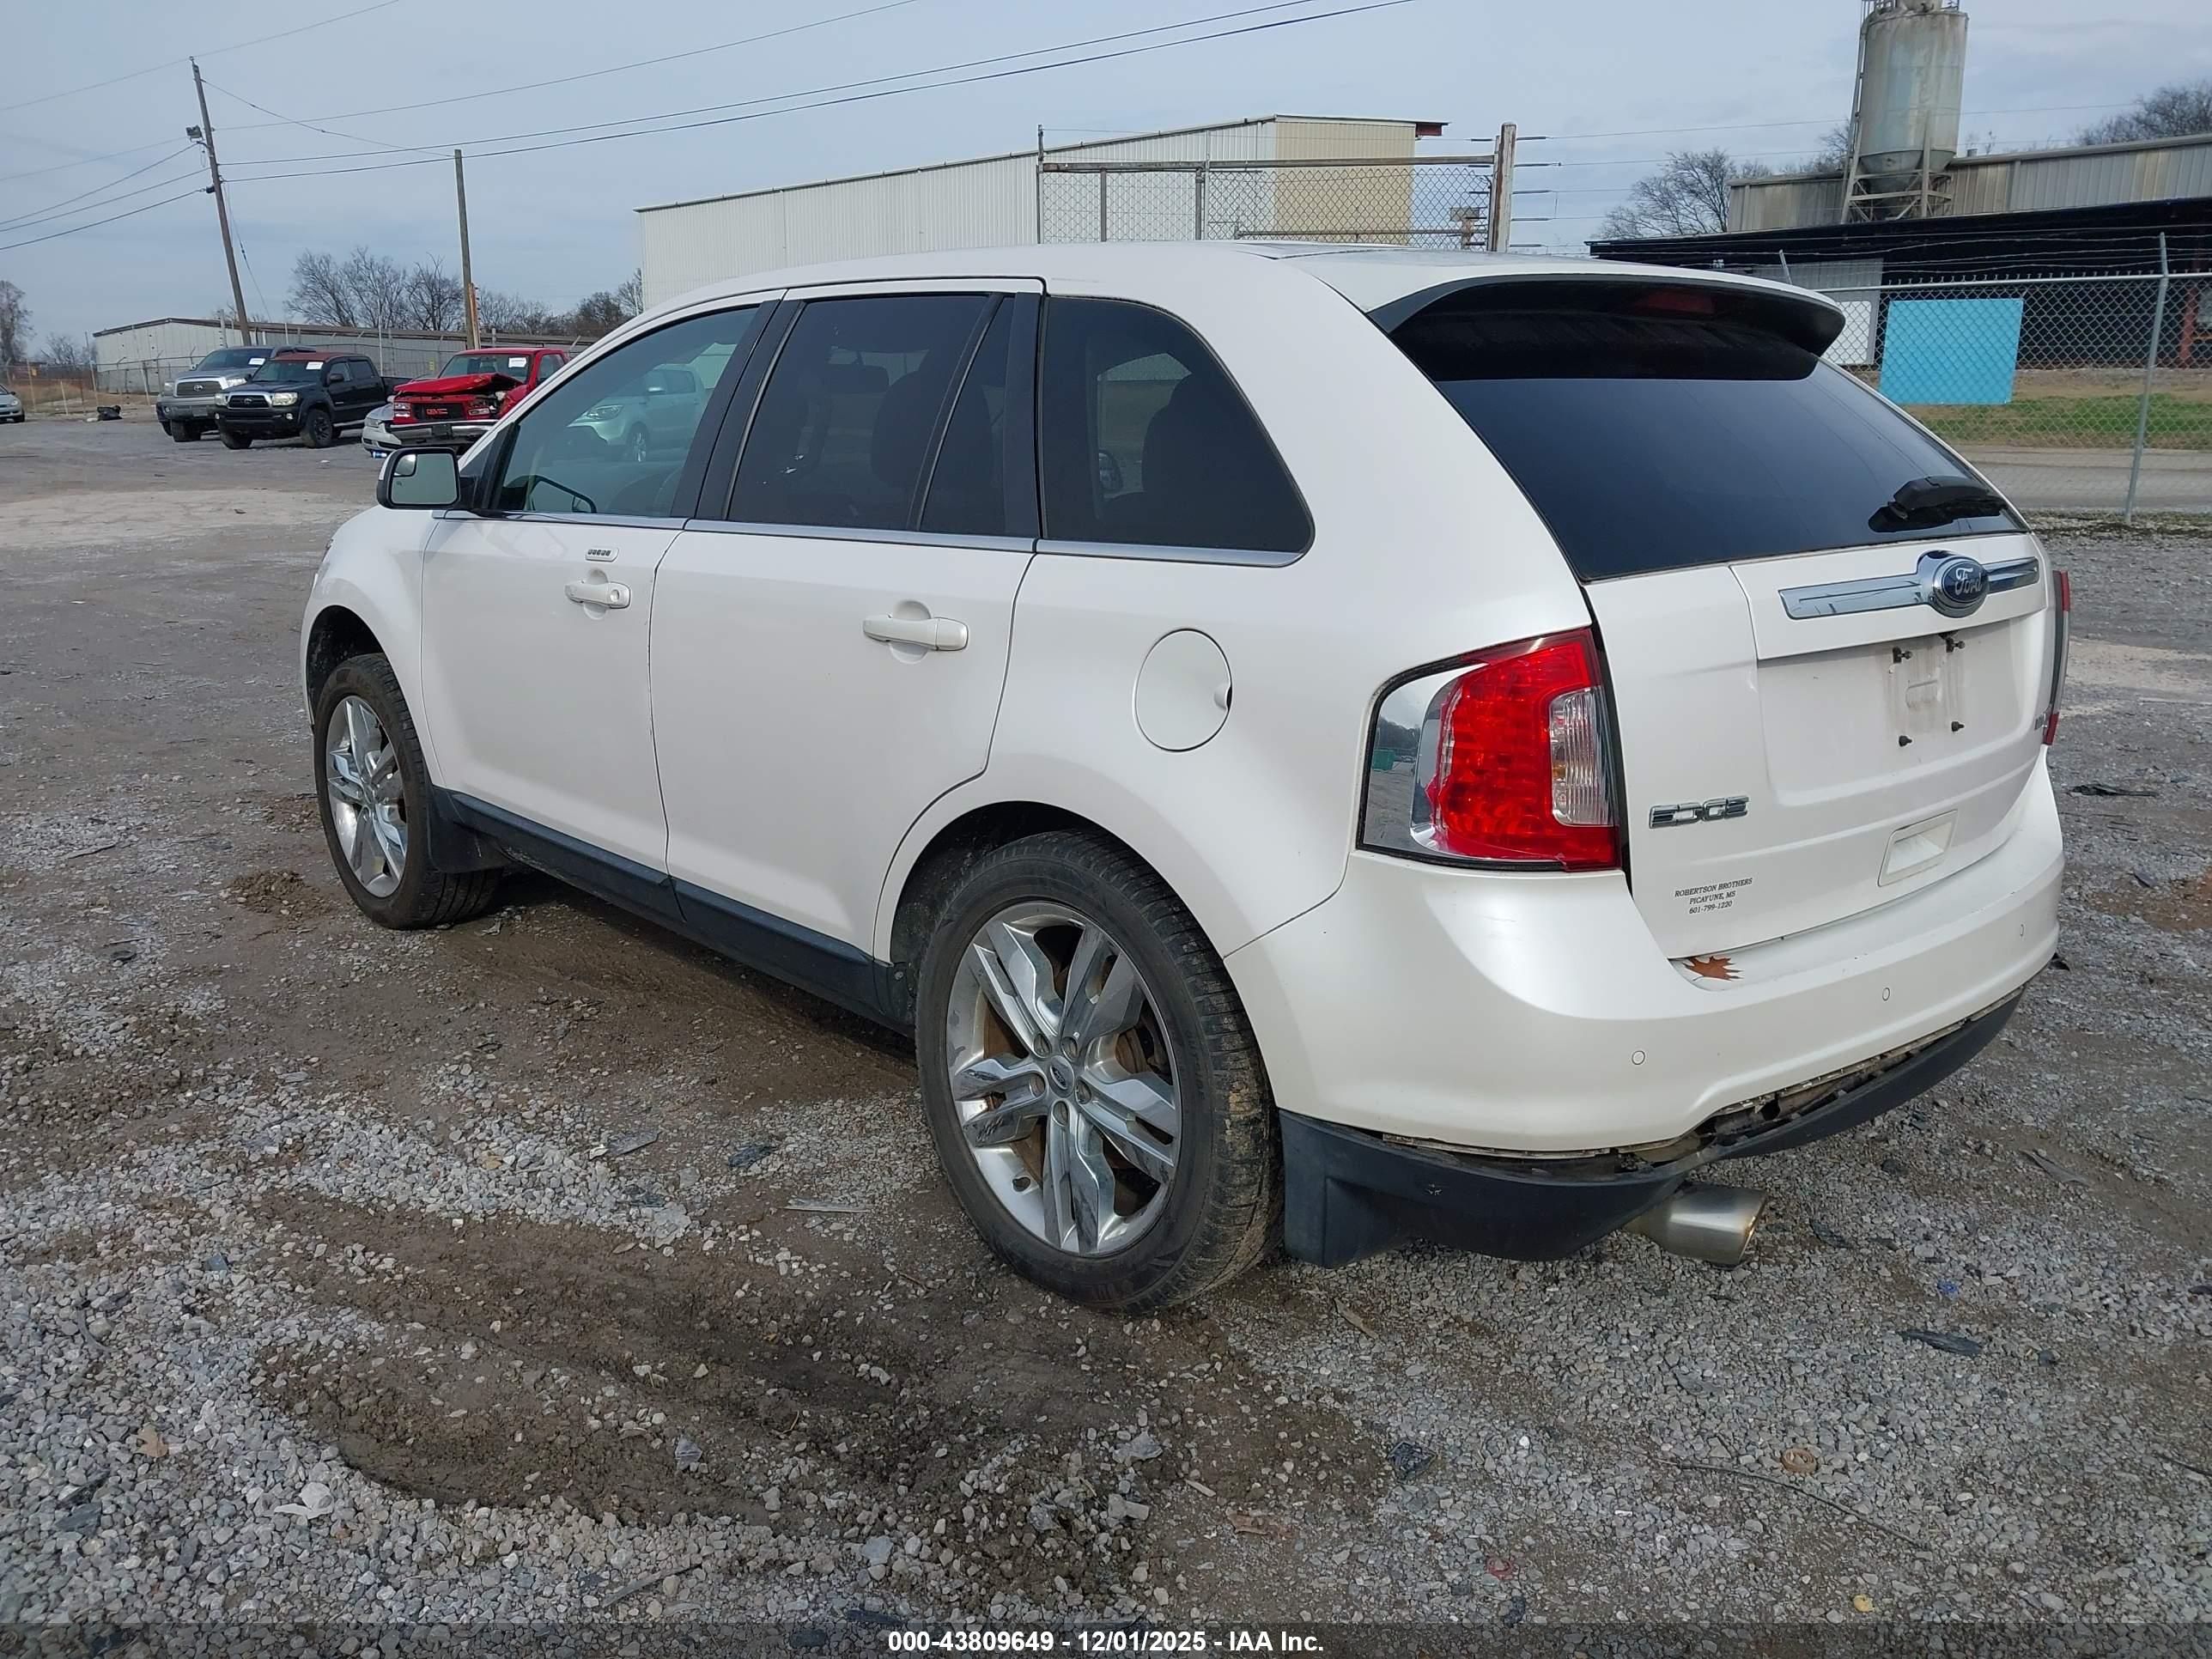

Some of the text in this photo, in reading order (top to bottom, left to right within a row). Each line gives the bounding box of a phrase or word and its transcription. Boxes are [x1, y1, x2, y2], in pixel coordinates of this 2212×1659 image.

[1954, 568, 1983, 595] Ford
[1649, 795, 1749, 829] EDGE
[1674, 878, 1753, 897] ROBERTSON BROTHERS
[1689, 890, 1736, 904] PICAYUNE, MS
[1689, 900, 1733, 914] 601-799-1220
